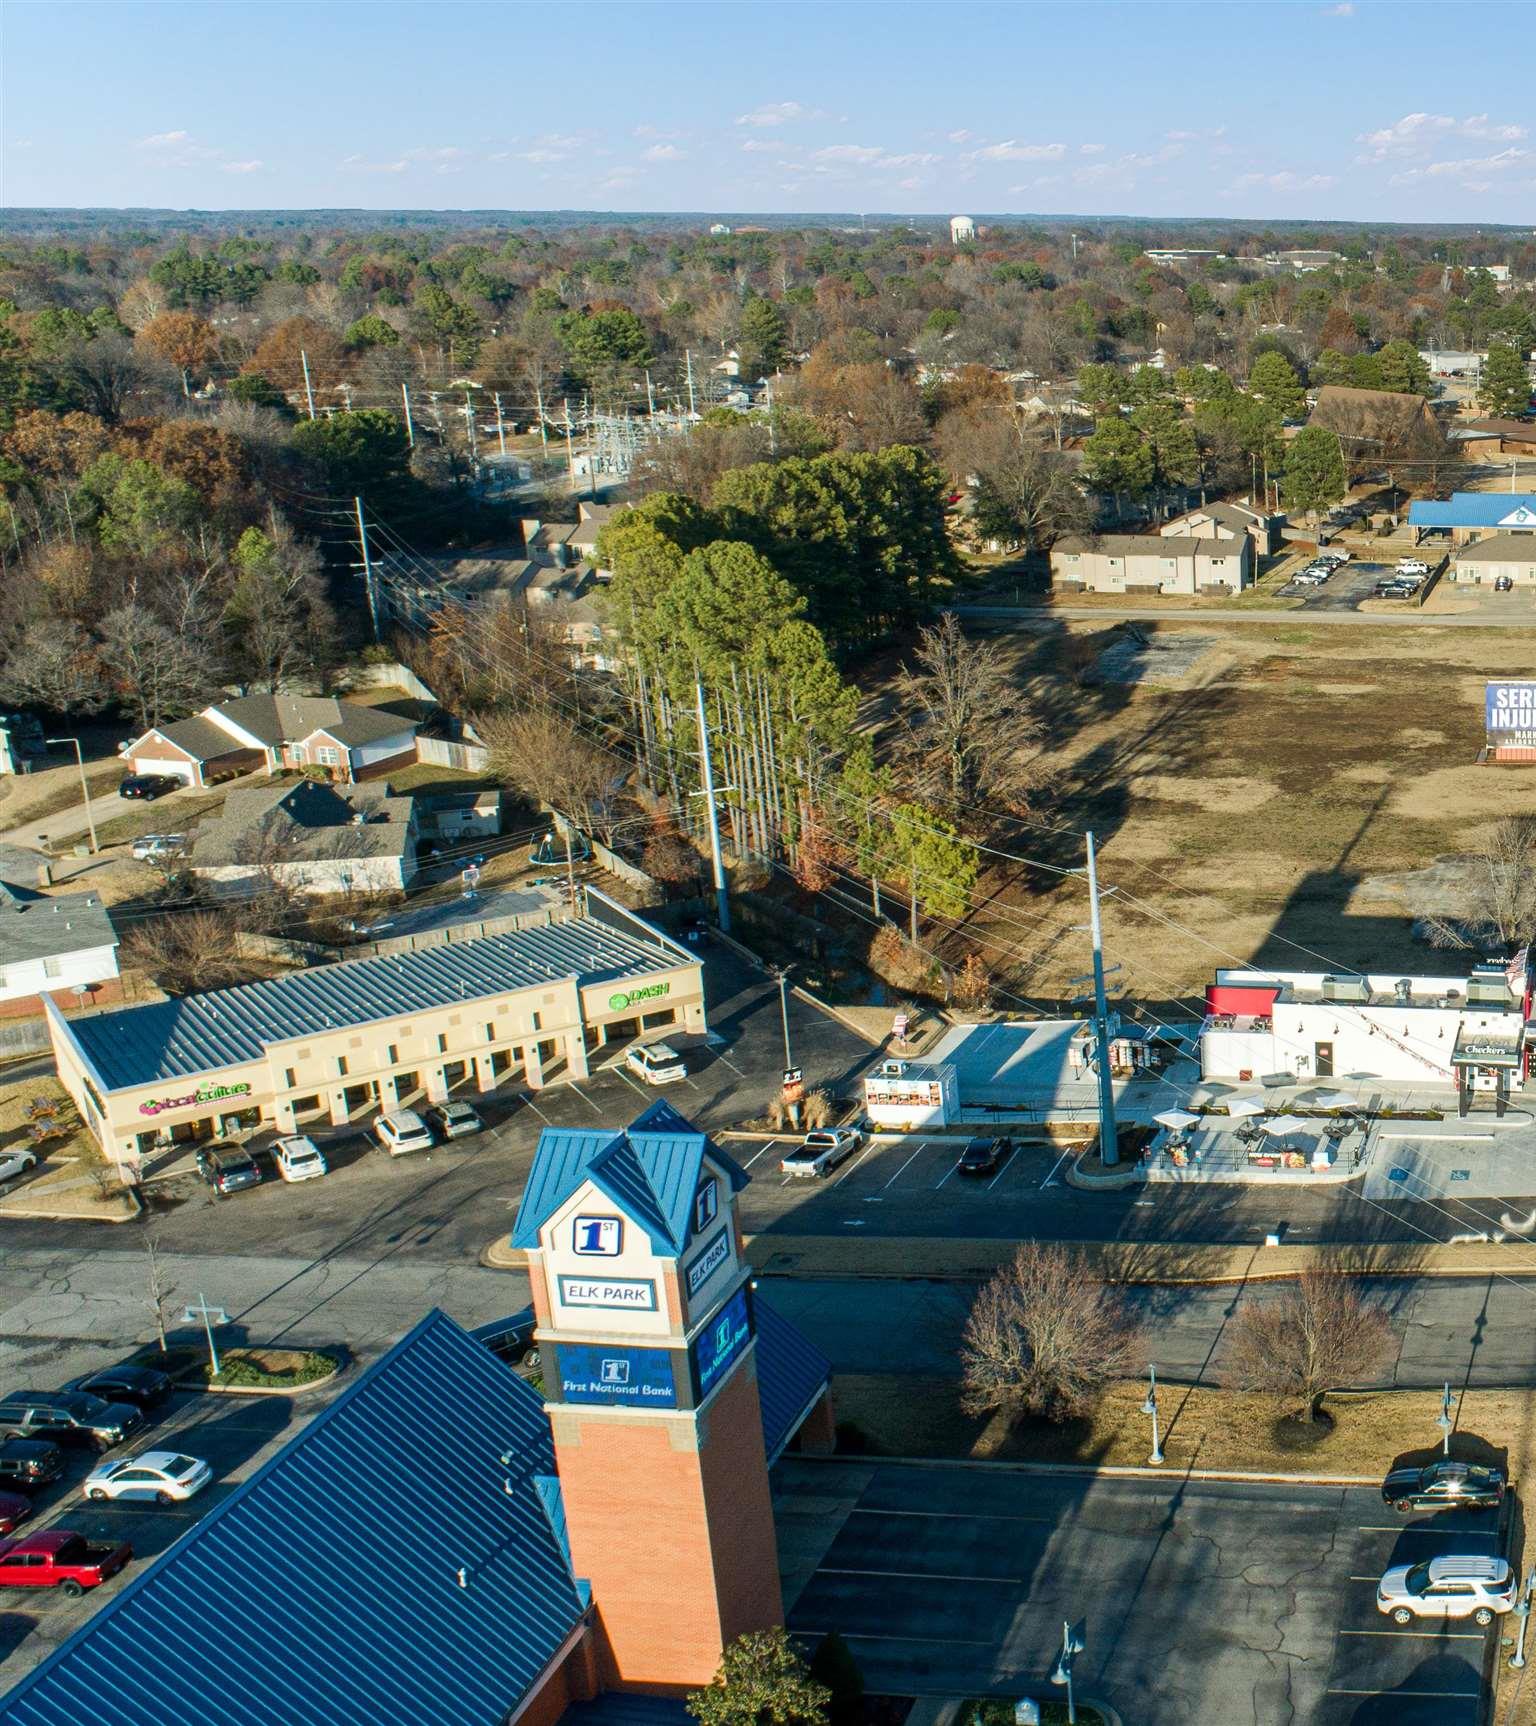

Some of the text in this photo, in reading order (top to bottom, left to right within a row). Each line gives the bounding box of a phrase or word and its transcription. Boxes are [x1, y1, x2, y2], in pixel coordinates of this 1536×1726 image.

[1515, 731, 1536, 739] MARK
[629, 982, 670, 1002] DASH
[1465, 1045, 1506, 1055] Checkers
[580, 1222, 614, 1251] 1ST
[691, 1242, 726, 1288] ELK PARK
[569, 1285, 646, 1301] ELK PARK
[563, 1381, 673, 1396] First National Bank
